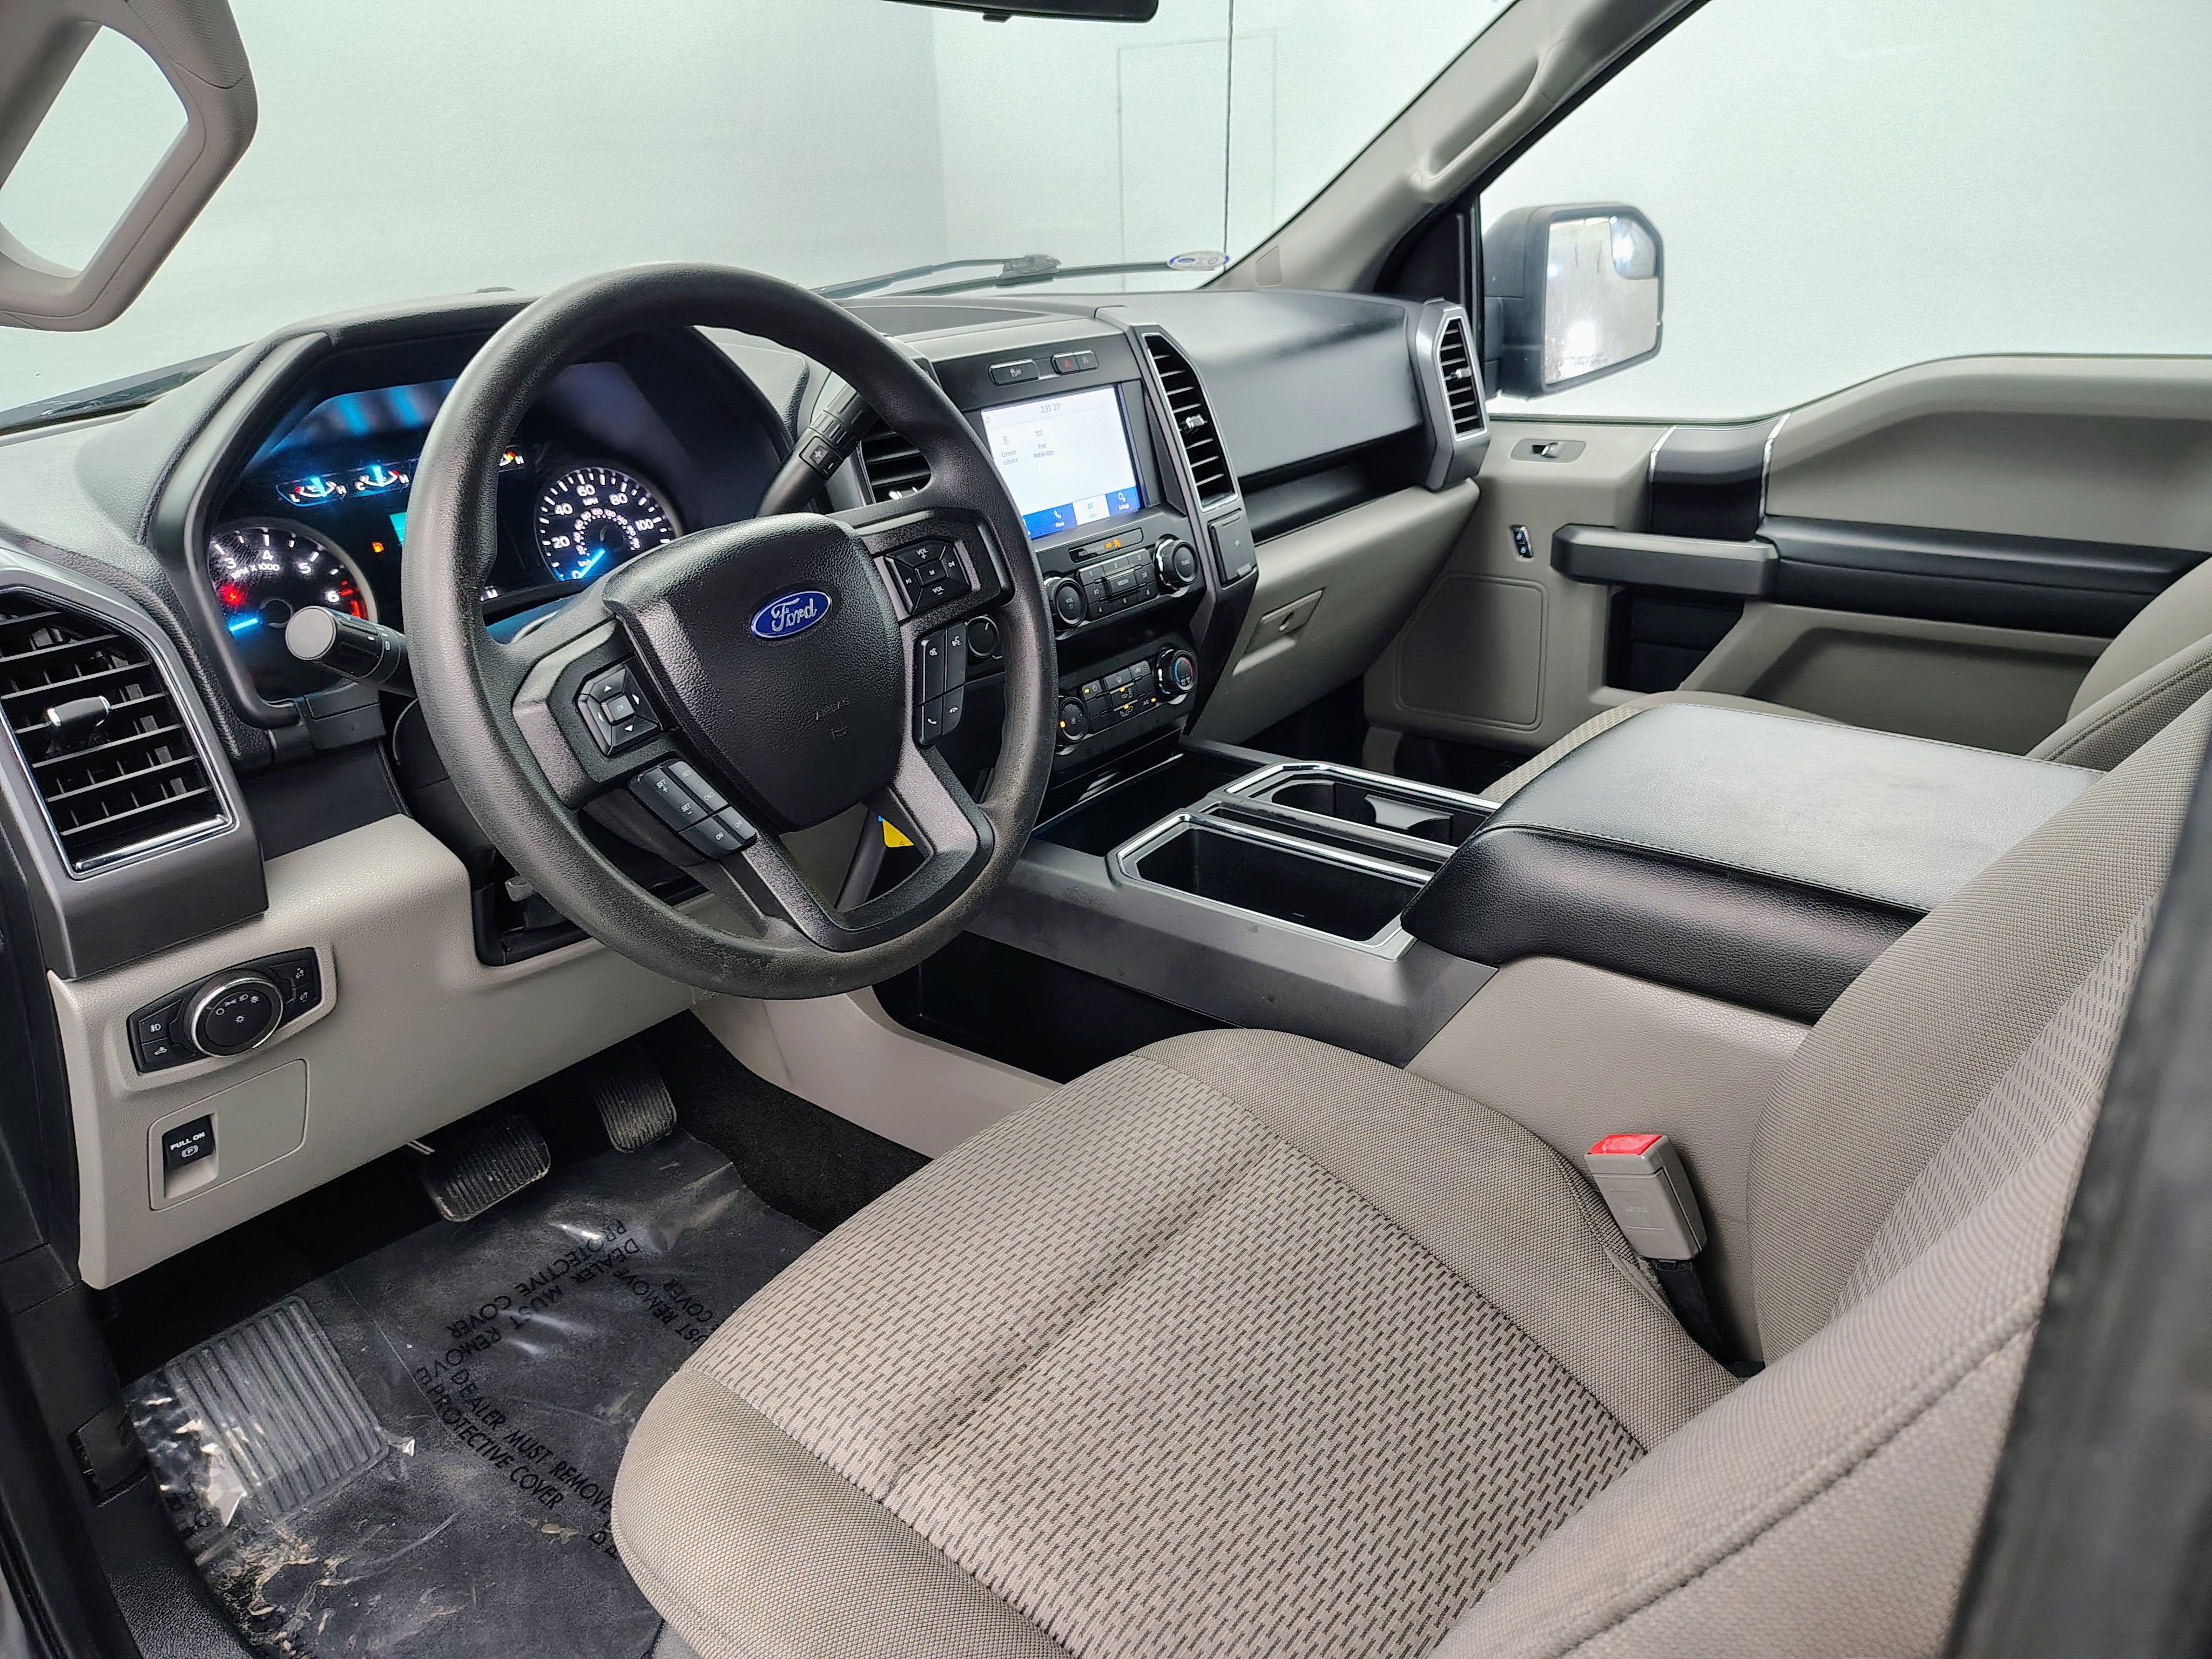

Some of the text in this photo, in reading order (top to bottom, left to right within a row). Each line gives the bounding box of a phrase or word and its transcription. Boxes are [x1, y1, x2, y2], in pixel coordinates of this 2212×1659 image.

[515, 455, 524, 464] H
[399, 475, 409, 483] H
[336, 485, 347, 494] H
[355, 482, 365, 490] C
[577, 484, 595, 496] 60
[289, 494, 300, 502] L
[582, 497, 599, 506] MPH
[609, 493, 628, 505] 80
[555, 503, 573, 515] 40
[635, 518, 654, 531] 100
[551, 536, 570, 549] 20
[263, 550, 273, 561] 4
[916, 548, 928, 556] VOL
[224, 557, 237, 569] 3
[299, 563, 311, 574] 5
[231, 568, 250, 579] RPM
[258, 563, 280, 571] 1000
[932, 585, 943, 593] VOL
[327, 591, 339, 602] 6
[771, 597, 817, 632] Ford
[682, 769, 692, 777] RES
[657, 779, 666, 788] SET
[681, 802, 691, 812] SET
[735, 820, 743, 828] OFF
[716, 832, 724, 840] ON
[170, 1132, 205, 1150] PULL ON
[446, 1219, 627, 1338] PROTECTIVE COVER
[613, 1266, 680, 1324] REMOVE
[664, 1278, 713, 1323] COVER
[415, 1238, 641, 1386] DEALER MUST REMOVE
[451, 1368, 506, 1430] DEALER
[504, 1430, 554, 1465] MUST
[427, 1381, 564, 1510] PROTECTIVE COVER
